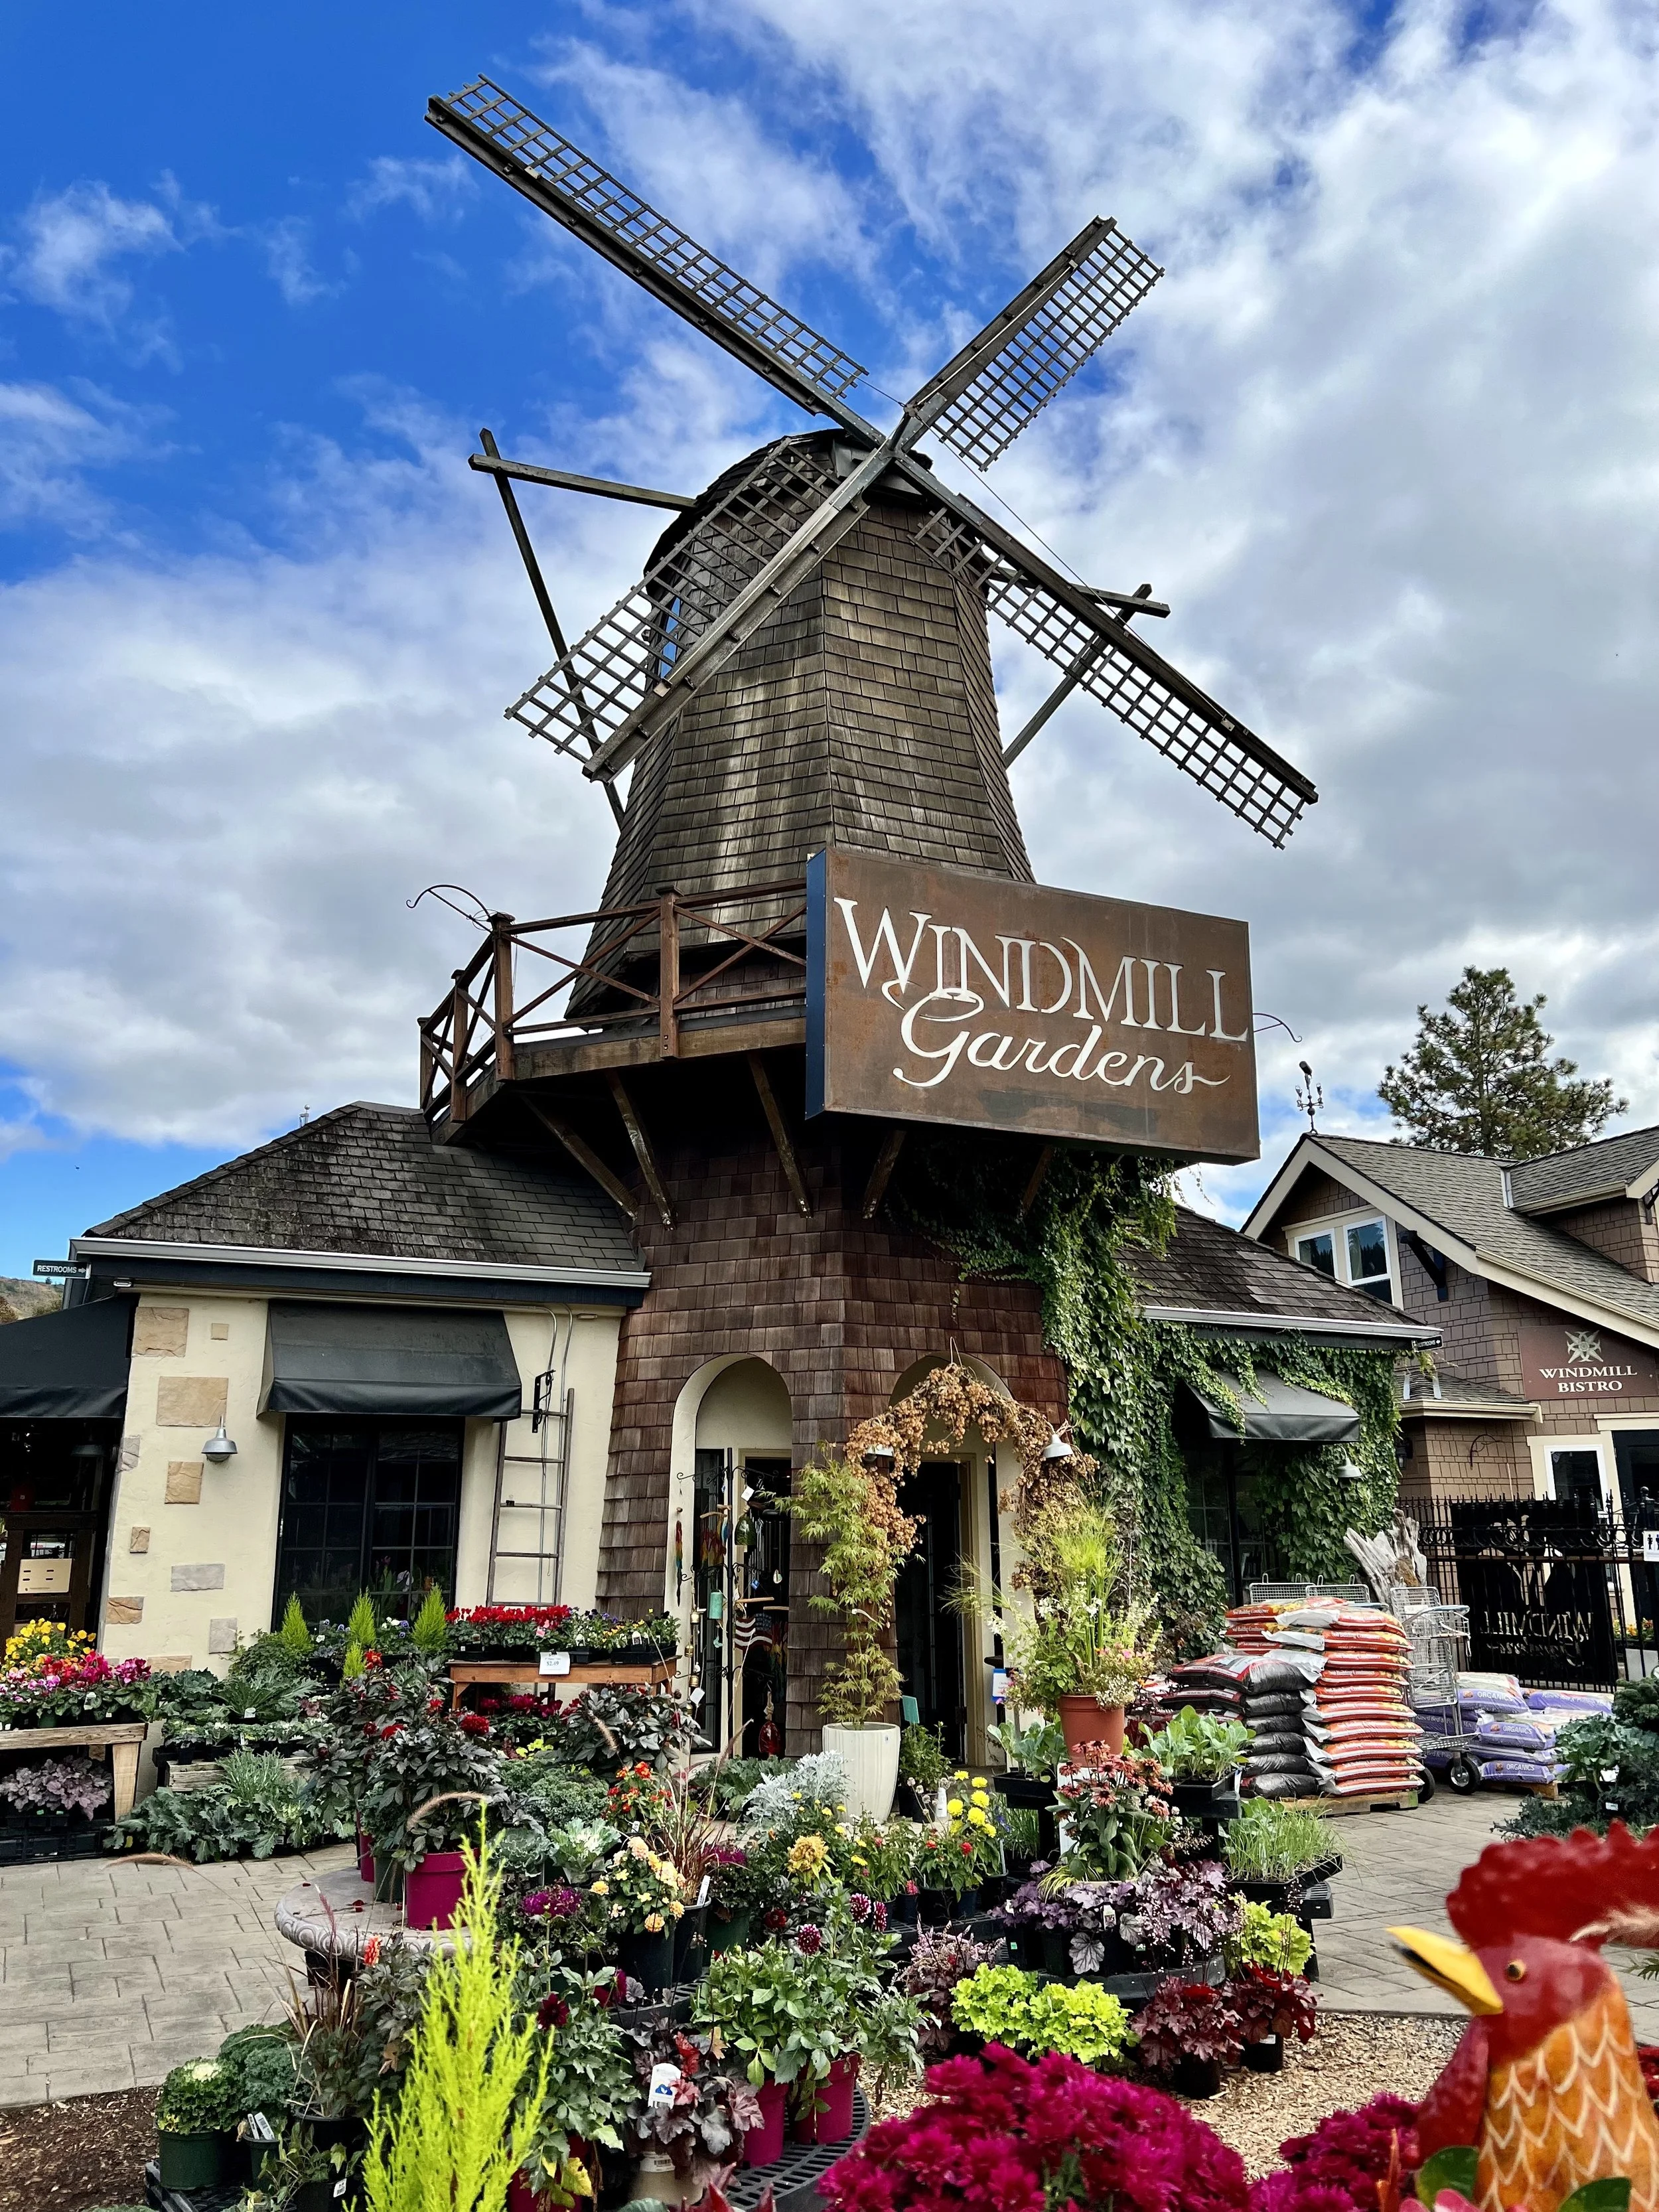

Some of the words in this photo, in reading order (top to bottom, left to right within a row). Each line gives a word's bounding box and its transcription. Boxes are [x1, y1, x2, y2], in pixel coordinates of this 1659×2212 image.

[833, 897, 1248, 1042] WINDMILL
[881, 980, 1230, 1094] Gardens
[36, 1265, 77, 1274] RESTROOMS
[1539, 1365, 1638, 1379] WINDMILL
[1557, 1380, 1623, 1393] BISTRO
[1477, 1692, 1513, 1702] ORGANICS
[1502, 1725, 1532, 1734] ORGANICS
